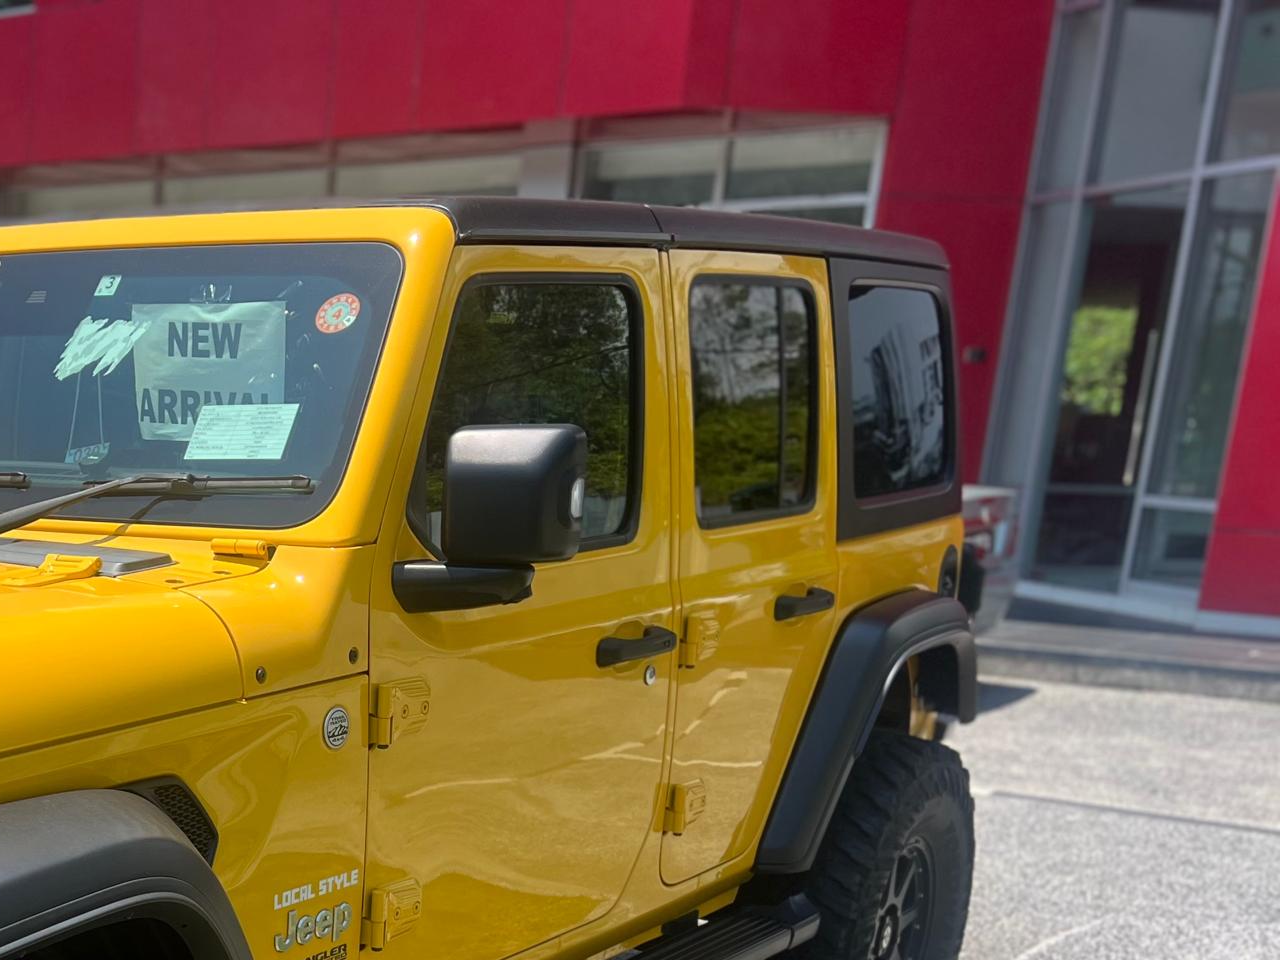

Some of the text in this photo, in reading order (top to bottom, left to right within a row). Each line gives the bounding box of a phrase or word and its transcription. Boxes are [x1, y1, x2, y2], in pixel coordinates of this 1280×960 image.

[167, 321, 243, 359] NEW
[273, 869, 360, 911] LOCAL STYLE
[274, 901, 353, 953] Jeep
